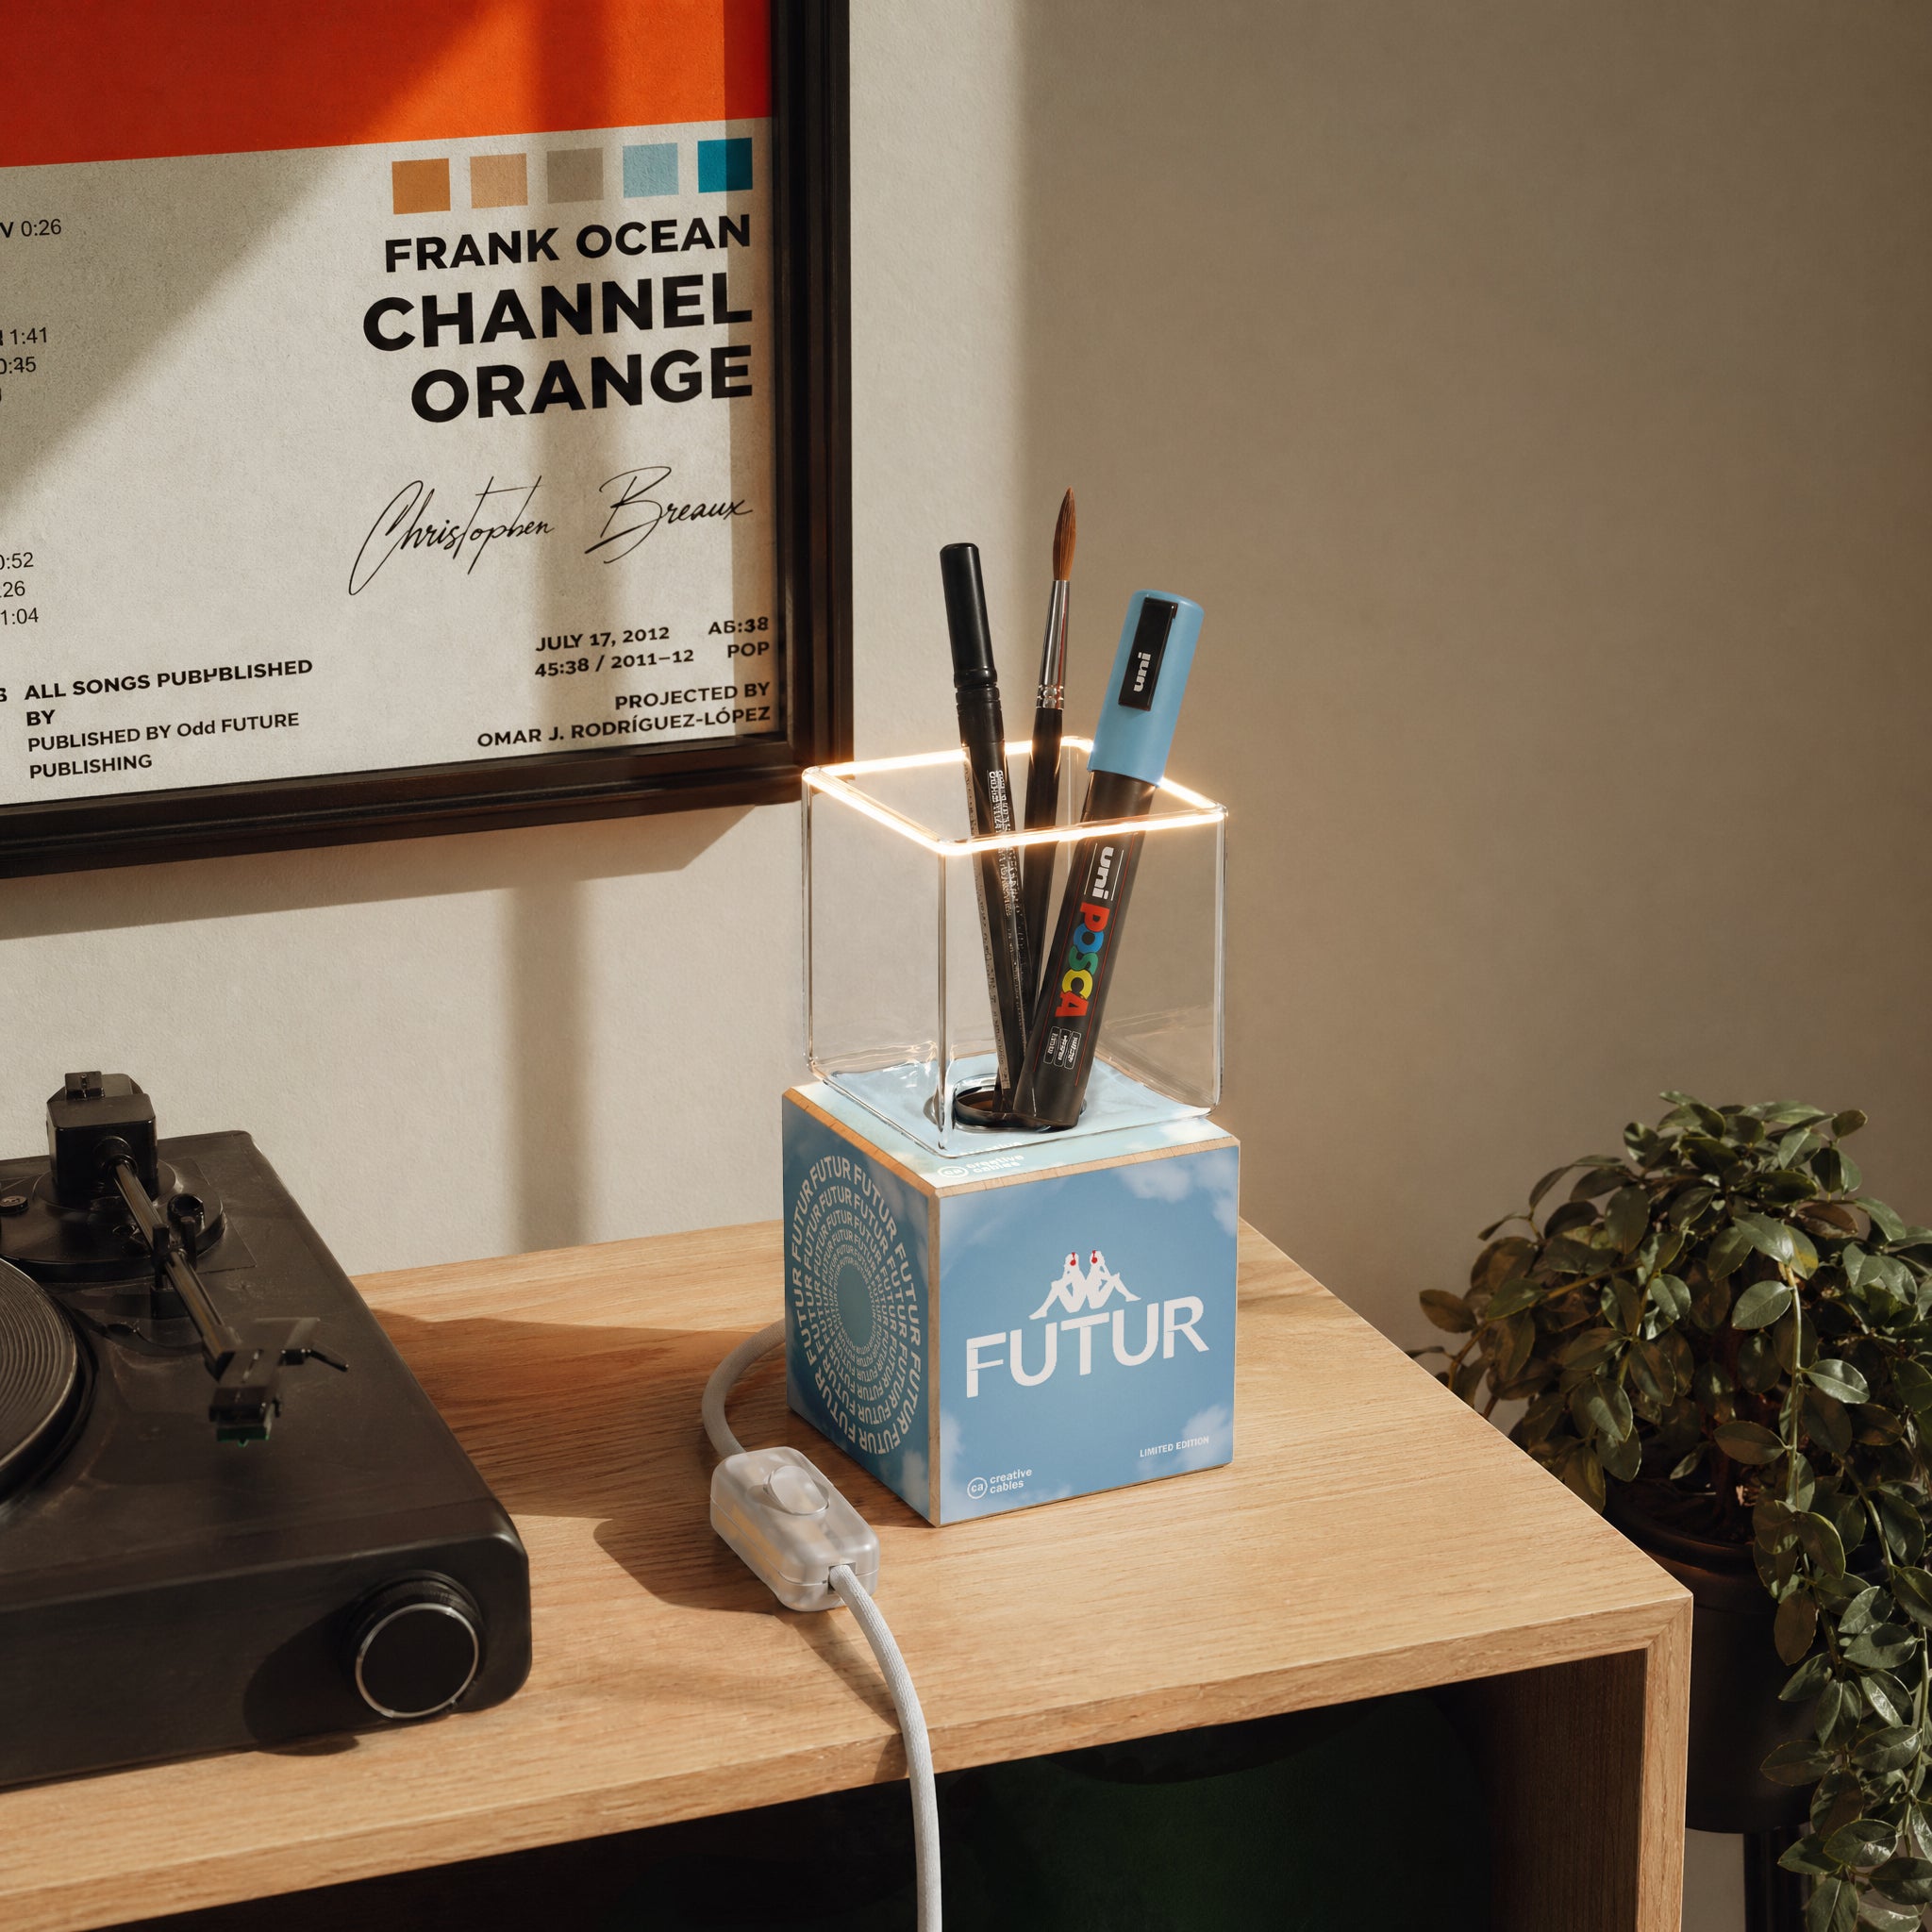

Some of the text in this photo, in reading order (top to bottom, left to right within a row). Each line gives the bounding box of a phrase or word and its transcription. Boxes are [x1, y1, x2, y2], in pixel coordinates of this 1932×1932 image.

[21, 219, 62, 237] 0:26
[385, 214, 751, 273] FRANK OCEAN
[364, 273, 753, 351] CHANNEL
[9, 326, 47, 344] 1:41
[411, 345, 754, 423] ORANGE
[584, 466, 754, 564] Breaux
[2, 608, 39, 625] 1:04
[535, 626, 670, 652] JULY 17, 2012
[727, 641, 770, 658] POP
[25, 683, 67, 700] ALL
[73, 675, 151, 696] SONGS
[535, 658, 590, 677] 45:38
[1133, 652, 1151, 692] uni
[615, 681, 771, 710] PROJECTED BY
[26, 709, 56, 726] BY
[27, 712, 300, 753] PUBLISHED BY Odd FUTURE
[477, 706, 771, 747] OMAR J. RODRÍGUEZ-LÓPEZ
[29, 754, 153, 779] PUBLISHING
[1092, 846, 1114, 900] uni
[1055, 902, 1110, 1017] POSCA
[809, 1156, 851, 1189] FUTUR
[818, 1185, 852, 1212] FUTUR
[854, 1163, 896, 1241] FUTUR
[791, 1178, 813, 1262] FUTUR
[804, 1204, 822, 1270] FUTUR
[854, 1192, 888, 1255] FUTUR
[804, 1274, 824, 1353] FUTUR
[886, 1255, 907, 1338] FUTUR
[894, 1242, 920, 1345] FUTUR
[791, 1267, 816, 1365] FUTUR
[966, 1296, 1209, 1399] FUTUR
[822, 1354, 855, 1415] FUTUR
[888, 1341, 908, 1407] FUTUR
[896, 1351, 921, 1434] FUTUR
[814, 1366, 855, 1442] FUTUR
[857, 1399, 891, 1424] FUTUR
[858, 1423, 901, 1454] FUTUR
[1140, 1436, 1209, 1458] LIMITED EDITION
[990, 1469, 1032, 1484] creative
[990, 1480, 1024, 1494] cables
